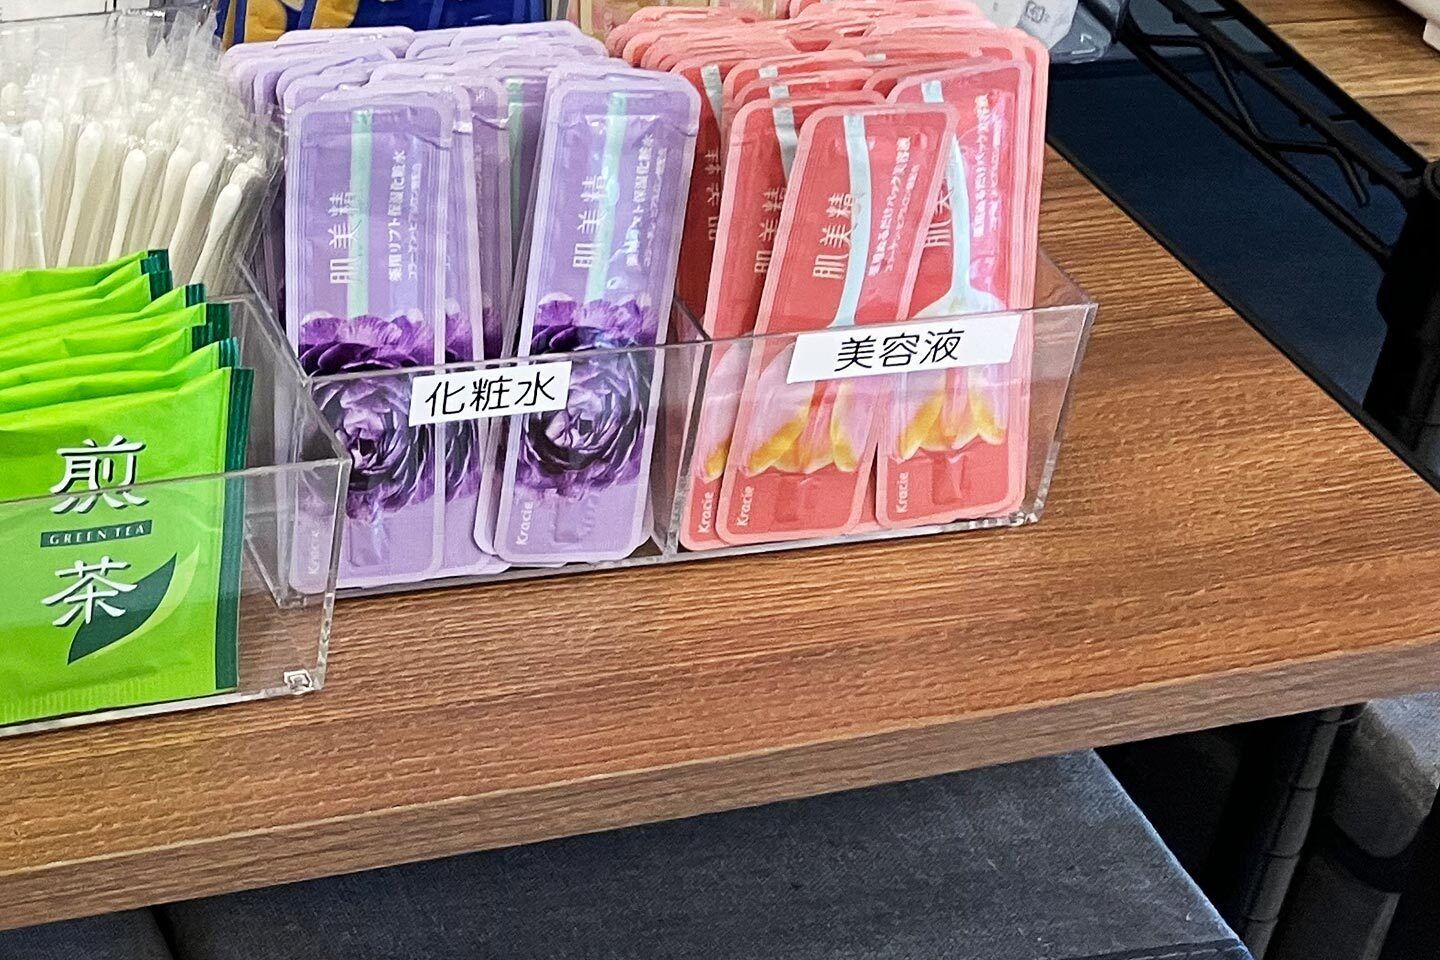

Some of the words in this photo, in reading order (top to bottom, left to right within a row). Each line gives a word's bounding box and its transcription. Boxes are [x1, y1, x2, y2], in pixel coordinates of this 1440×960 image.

[813, 192, 862, 279] 肌美精
[835, 328, 964, 373] 美容液
[424, 377, 557, 417] 化粧水
[698, 490, 713, 534] Kracie
[736, 485, 754, 527] Kracie
[896, 471, 910, 514] Kracie
[48, 531, 108, 545] GREEN
[114, 524, 145, 538] TEA
[514, 500, 533, 547] Kracie
